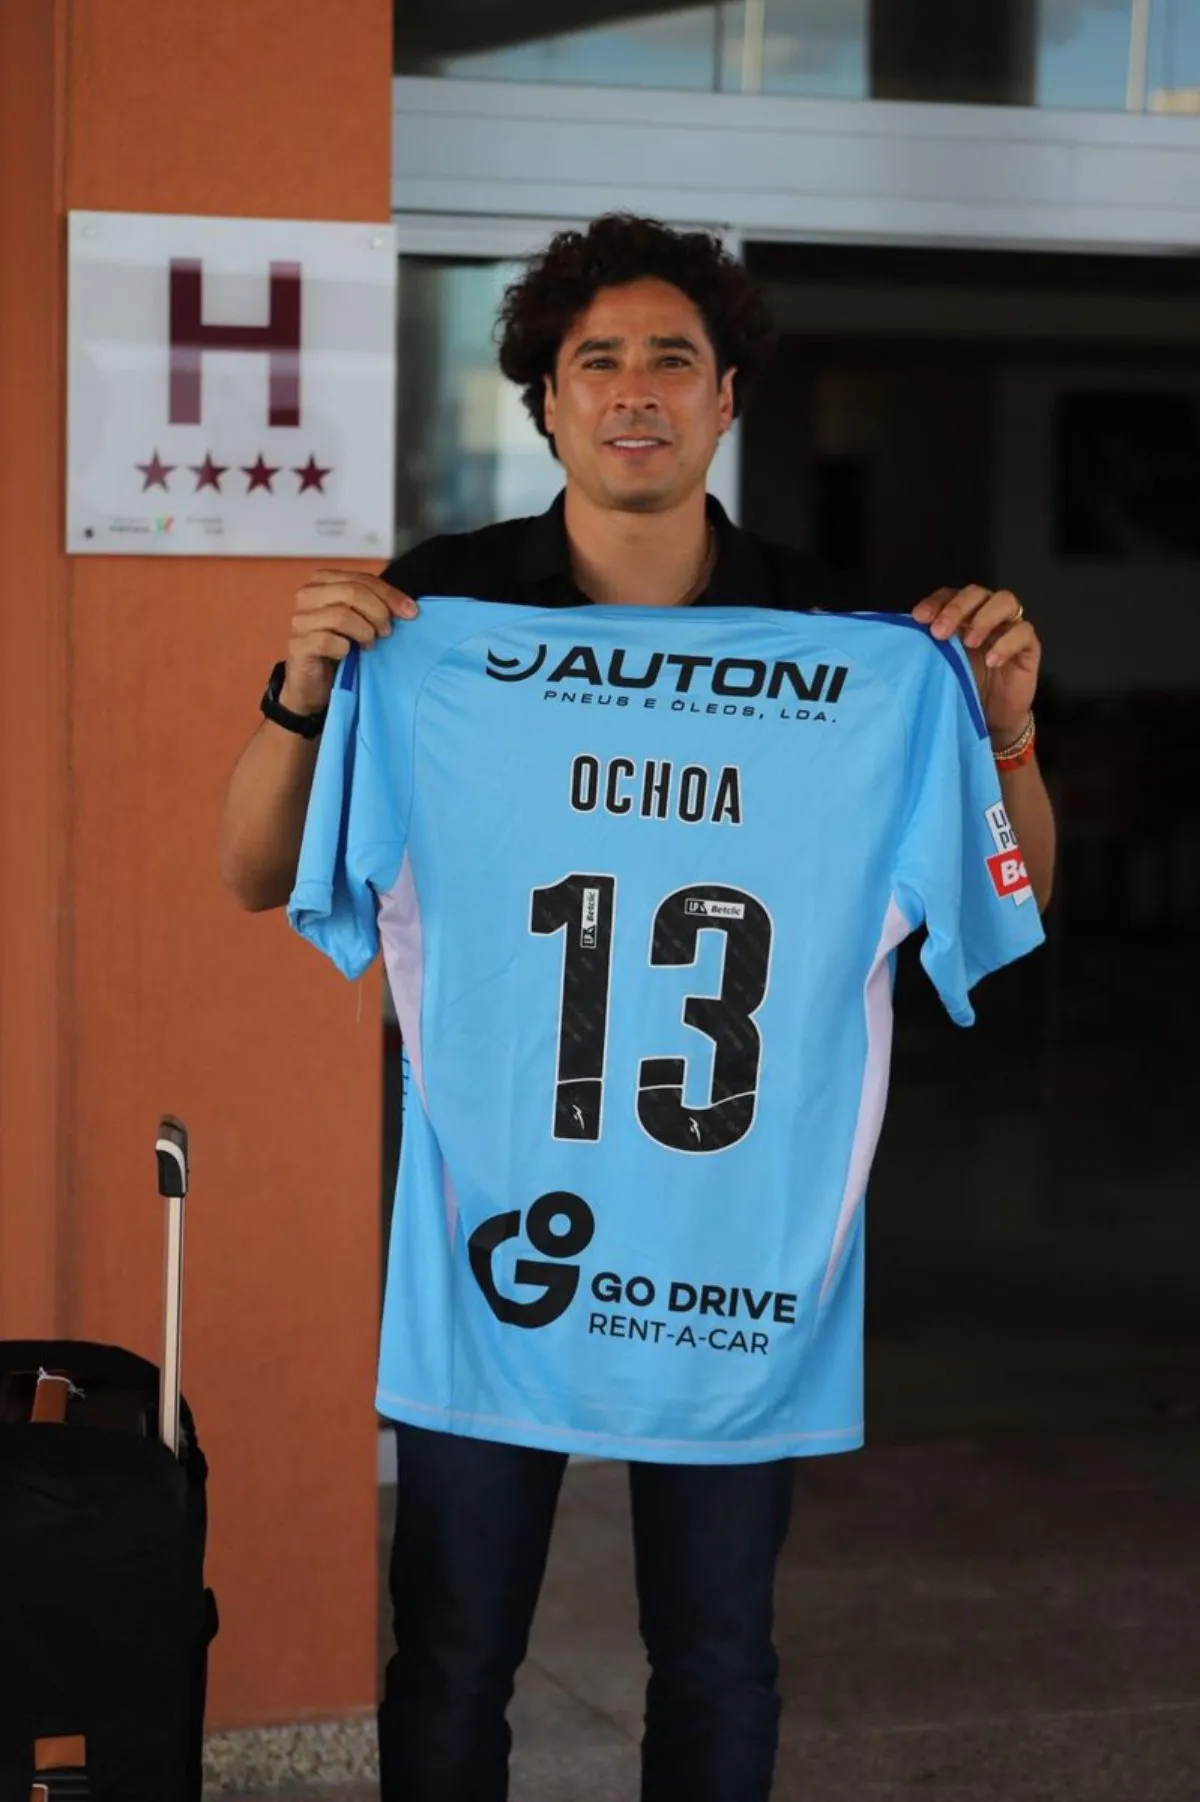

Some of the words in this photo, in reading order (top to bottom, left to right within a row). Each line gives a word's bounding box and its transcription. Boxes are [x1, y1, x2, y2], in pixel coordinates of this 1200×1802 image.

[169, 258, 302, 428] H
[546, 646, 849, 703] AUTONI
[544, 690, 630, 707] PNEUS
[643, 698, 657, 709] E
[780, 708, 837, 724] LDA.
[570, 754, 742, 826] OCHOA
[528, 872, 774, 1155] 13
[591, 1271, 656, 1307] GO
[668, 1281, 797, 1324] DRIVE
[588, 1312, 769, 1355] RENT-A-CAR
